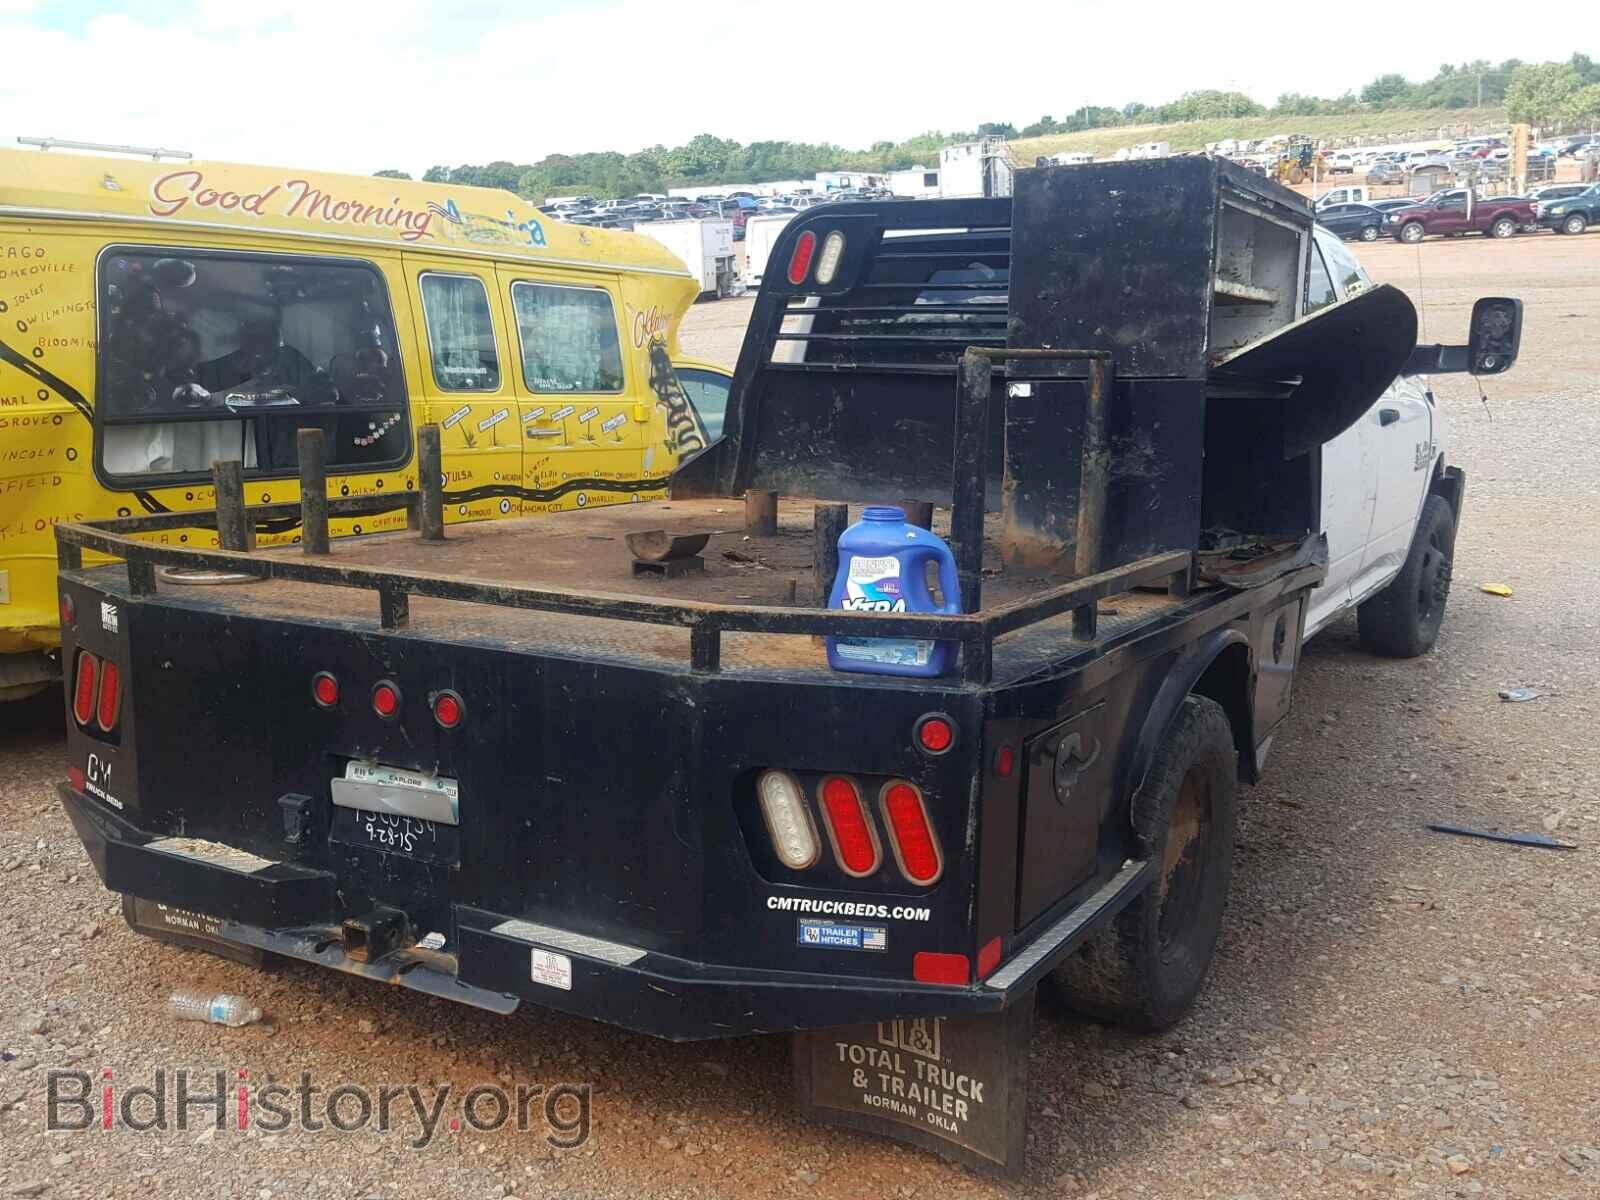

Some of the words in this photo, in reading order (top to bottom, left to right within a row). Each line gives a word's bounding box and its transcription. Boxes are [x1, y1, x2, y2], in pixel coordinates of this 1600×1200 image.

[149, 170, 281, 217] Good
[286, 179, 435, 242] Morning
[0, 475, 62, 493] FIELD
[446, 470, 473, 482] TULSA
[766, 896, 931, 922] CMTRUCKBEDS.COM
[820, 927, 859, 938] TRAILER
[820, 936, 859, 946] HITCHES
[835, 1042, 906, 1074] TOTAL
[914, 1059, 984, 1103] TRUCK
[852, 1067, 869, 1089] &
[878, 1073, 968, 1122] TRAILER
[863, 1093, 917, 1121] NORMAN
[926, 1112, 958, 1135] OKLA
